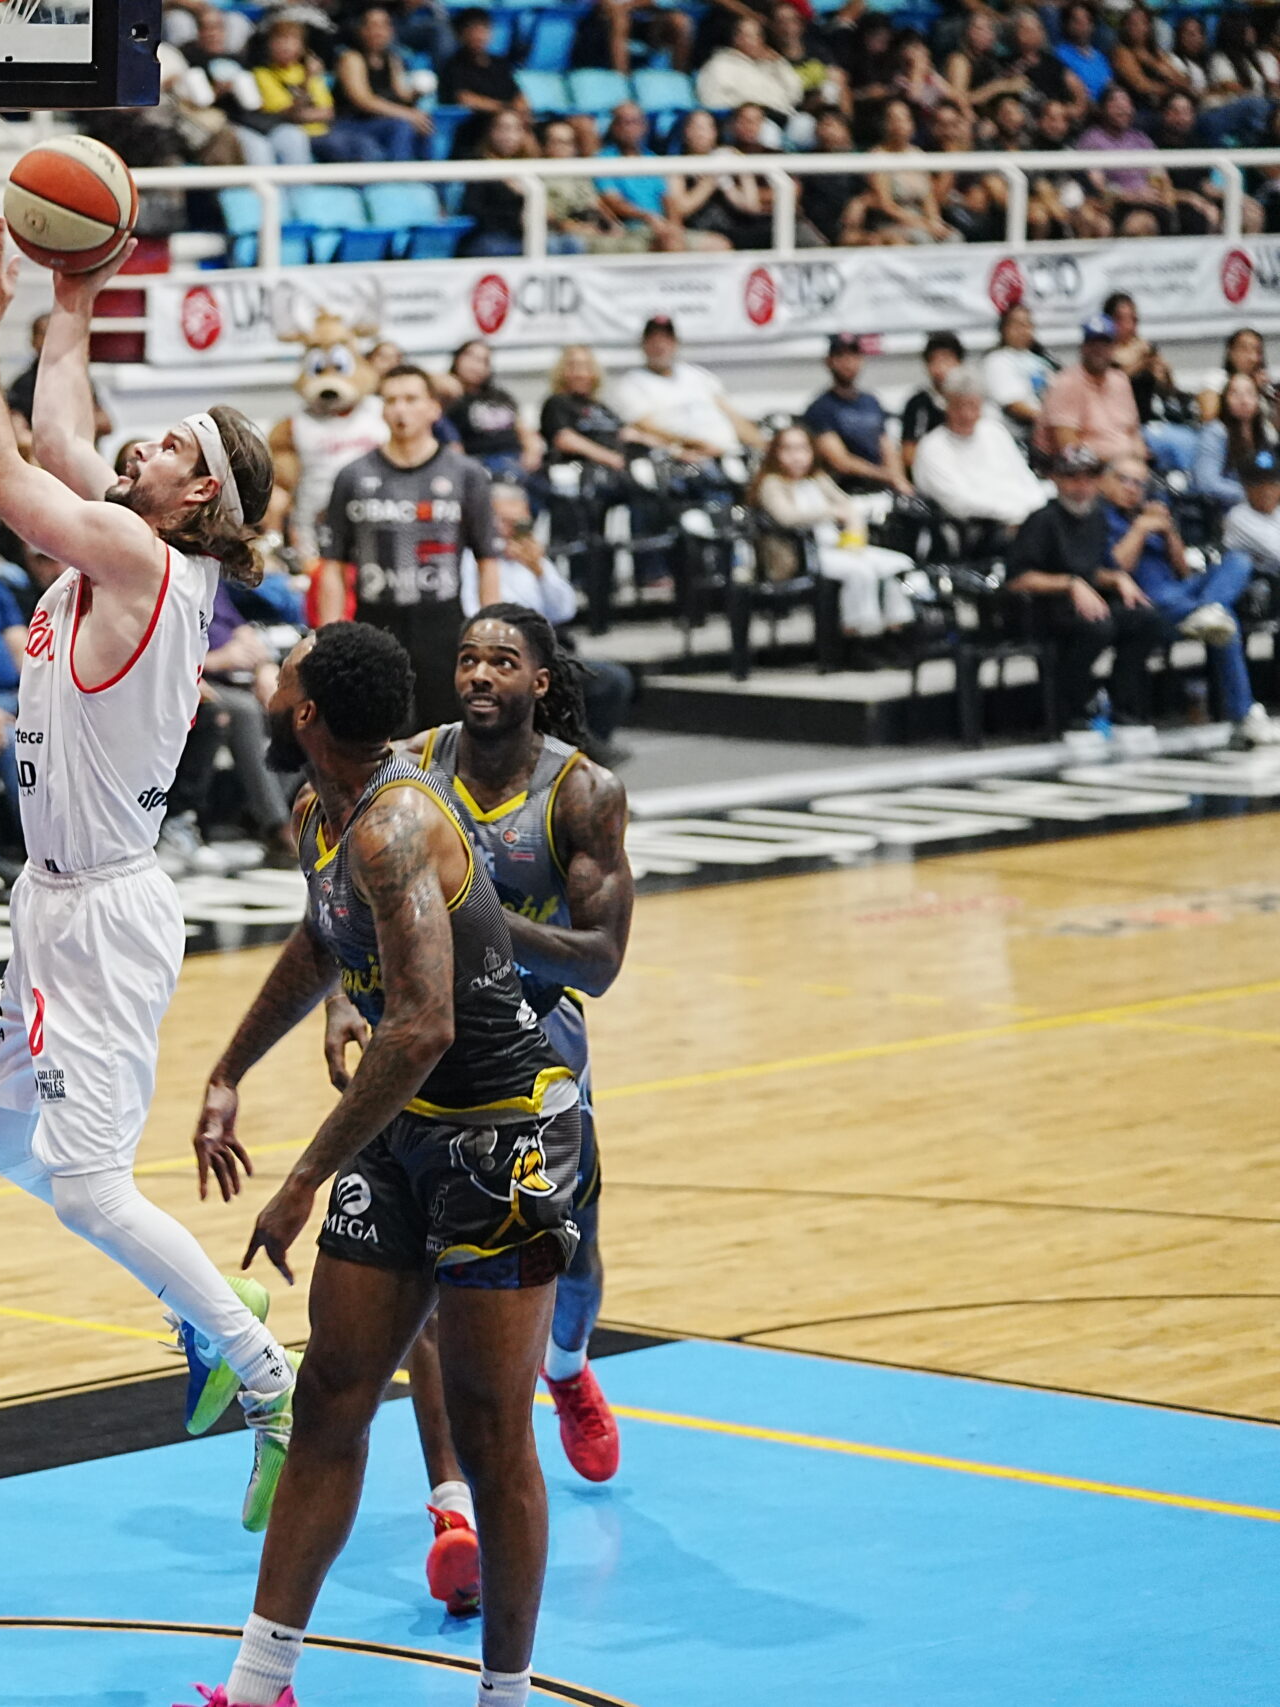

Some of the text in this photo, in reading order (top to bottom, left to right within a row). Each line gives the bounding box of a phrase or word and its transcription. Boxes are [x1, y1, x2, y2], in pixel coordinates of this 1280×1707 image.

[37, 1069, 64, 1080] COLEGIO
[40, 1080, 65, 1093] INGLÉS
[323, 1212, 379, 1244] MEGA
